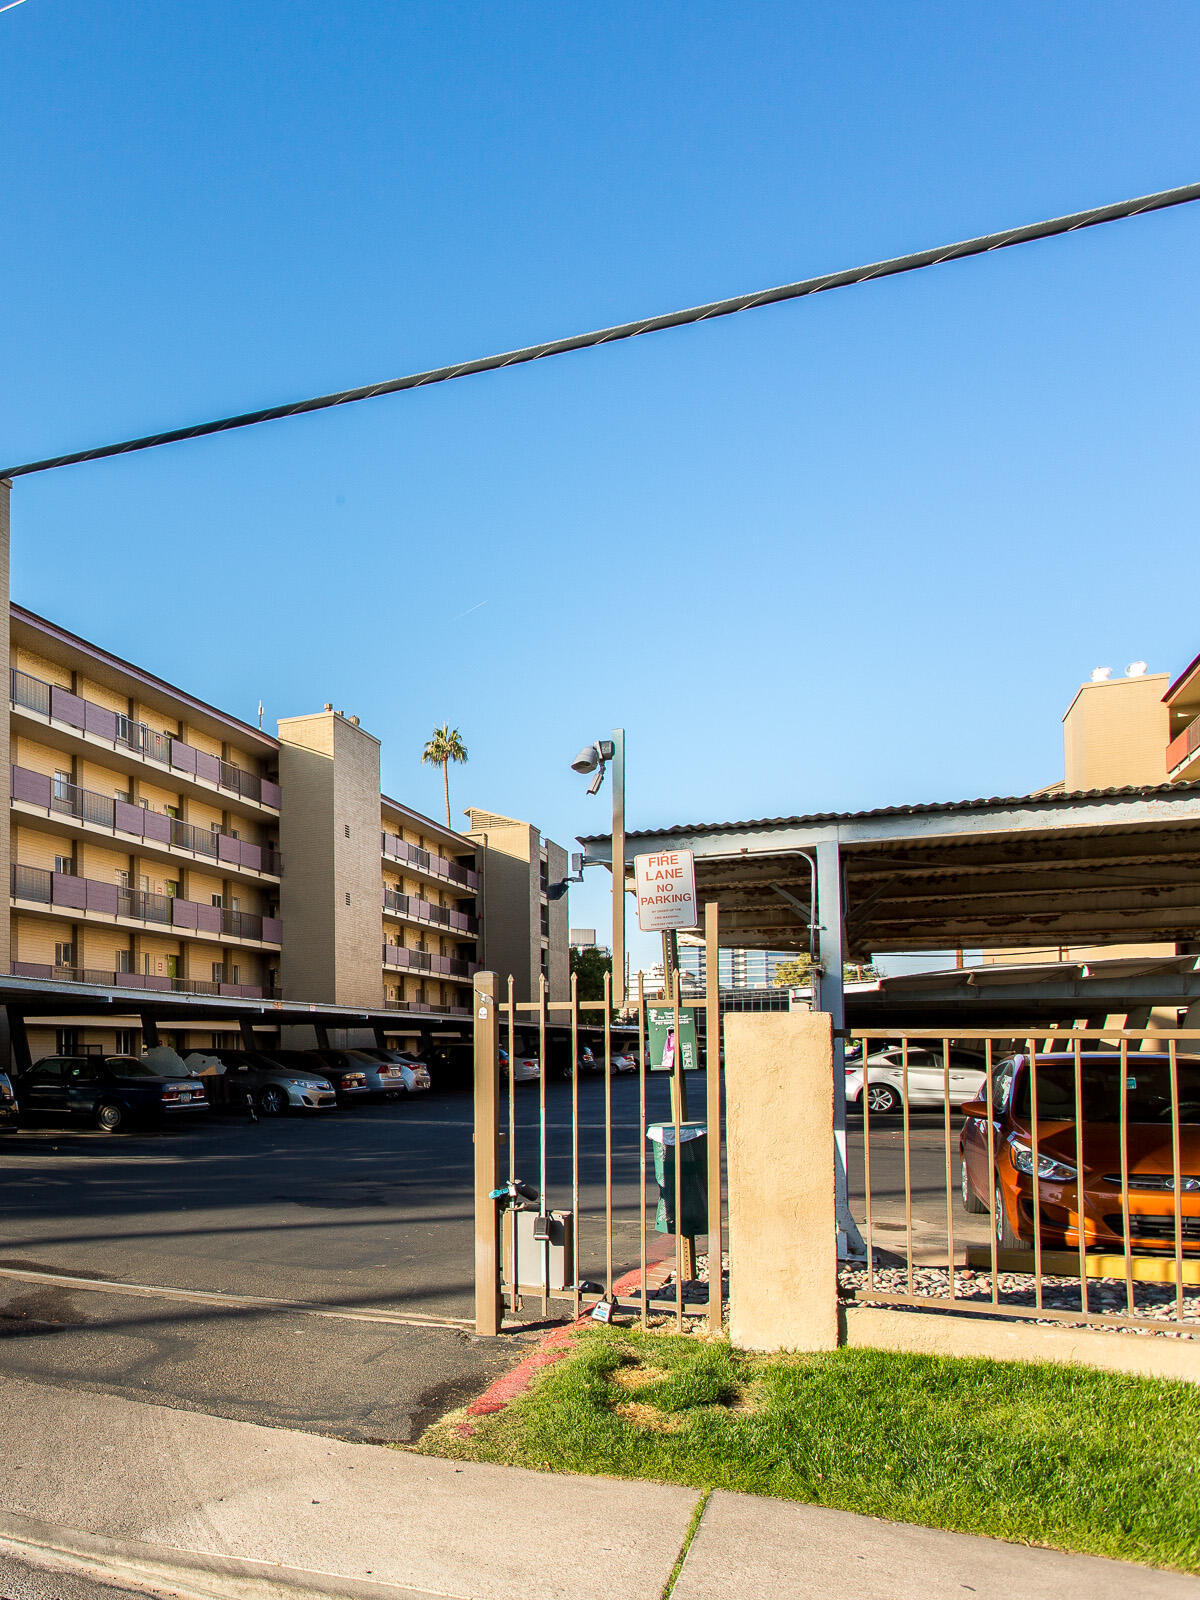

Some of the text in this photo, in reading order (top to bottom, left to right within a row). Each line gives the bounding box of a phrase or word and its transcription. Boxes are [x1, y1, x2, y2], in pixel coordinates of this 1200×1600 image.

[648, 854, 679, 867] FIRE
[645, 868, 684, 881] LANE
[656, 883, 674, 893] NO
[640, 893, 692, 905] PARKING
